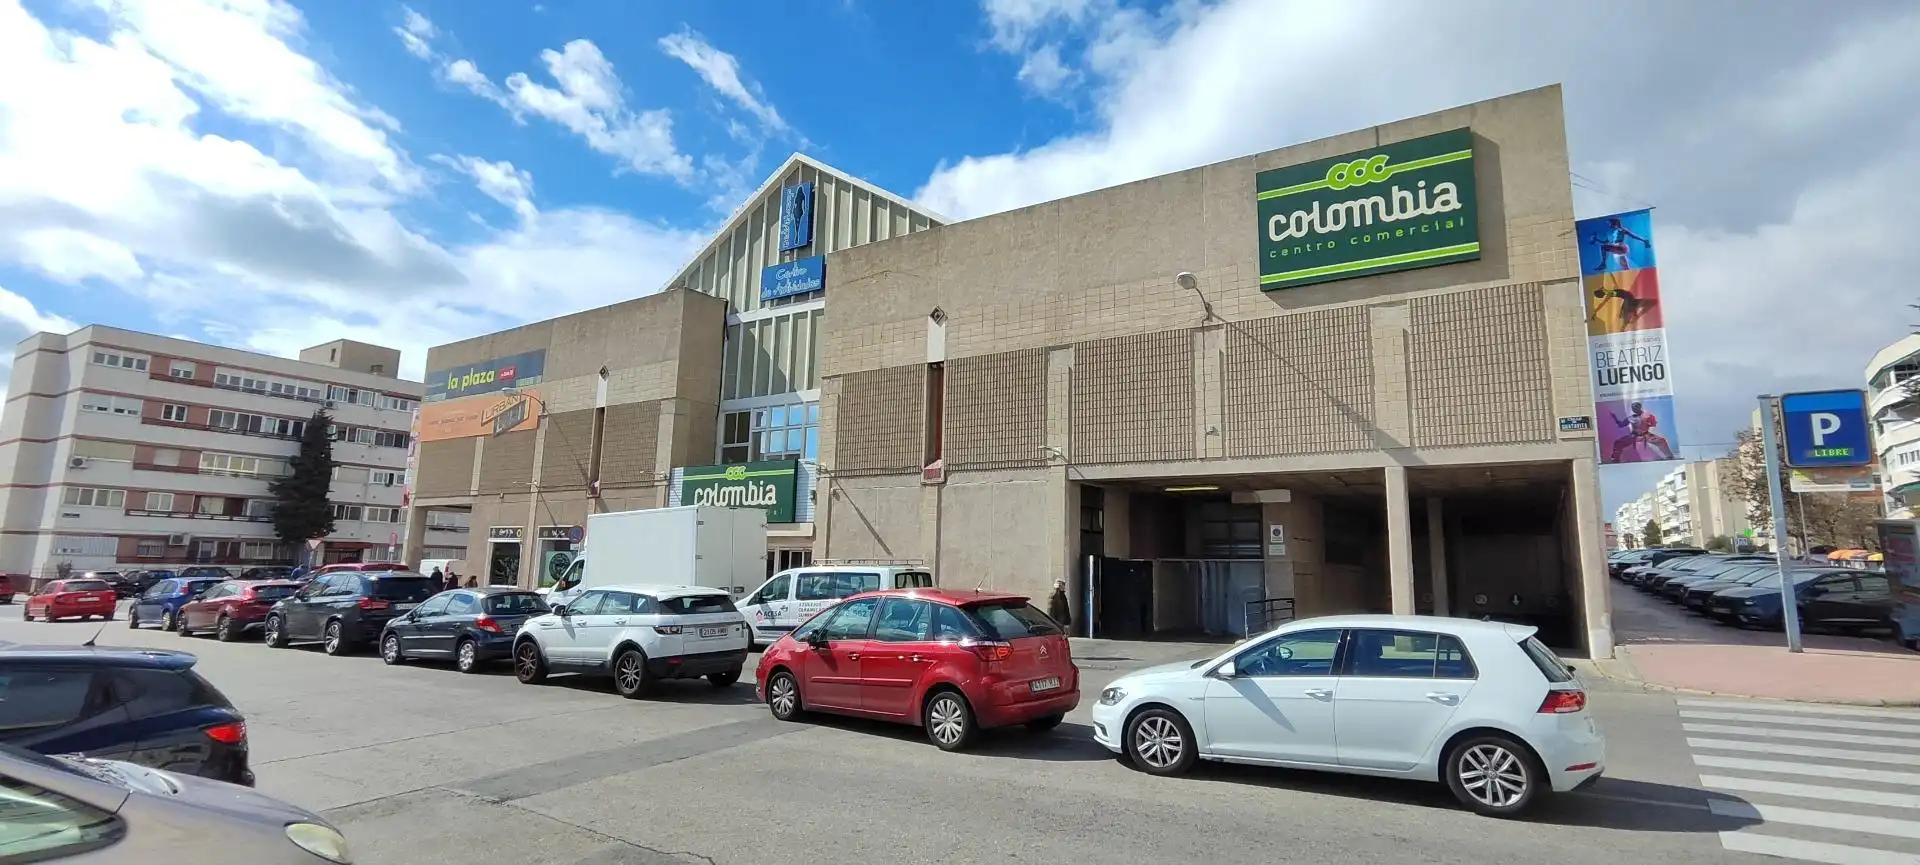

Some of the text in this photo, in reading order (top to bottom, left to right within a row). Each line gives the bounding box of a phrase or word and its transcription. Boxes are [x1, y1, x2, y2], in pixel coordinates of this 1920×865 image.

[1269, 180, 1462, 242] colombia
[1270, 217, 1464, 258] centro comercial
[1595, 345, 1663, 368] BEATRIZ
[447, 371, 458, 390] la
[461, 367, 495, 392] plaza
[1597, 363, 1665, 387] LUENGO
[483, 395, 520, 419] URBAN
[1811, 412, 1840, 446] P
[1815, 448, 1849, 457] LIBRE
[694, 480, 777, 506] colombia
